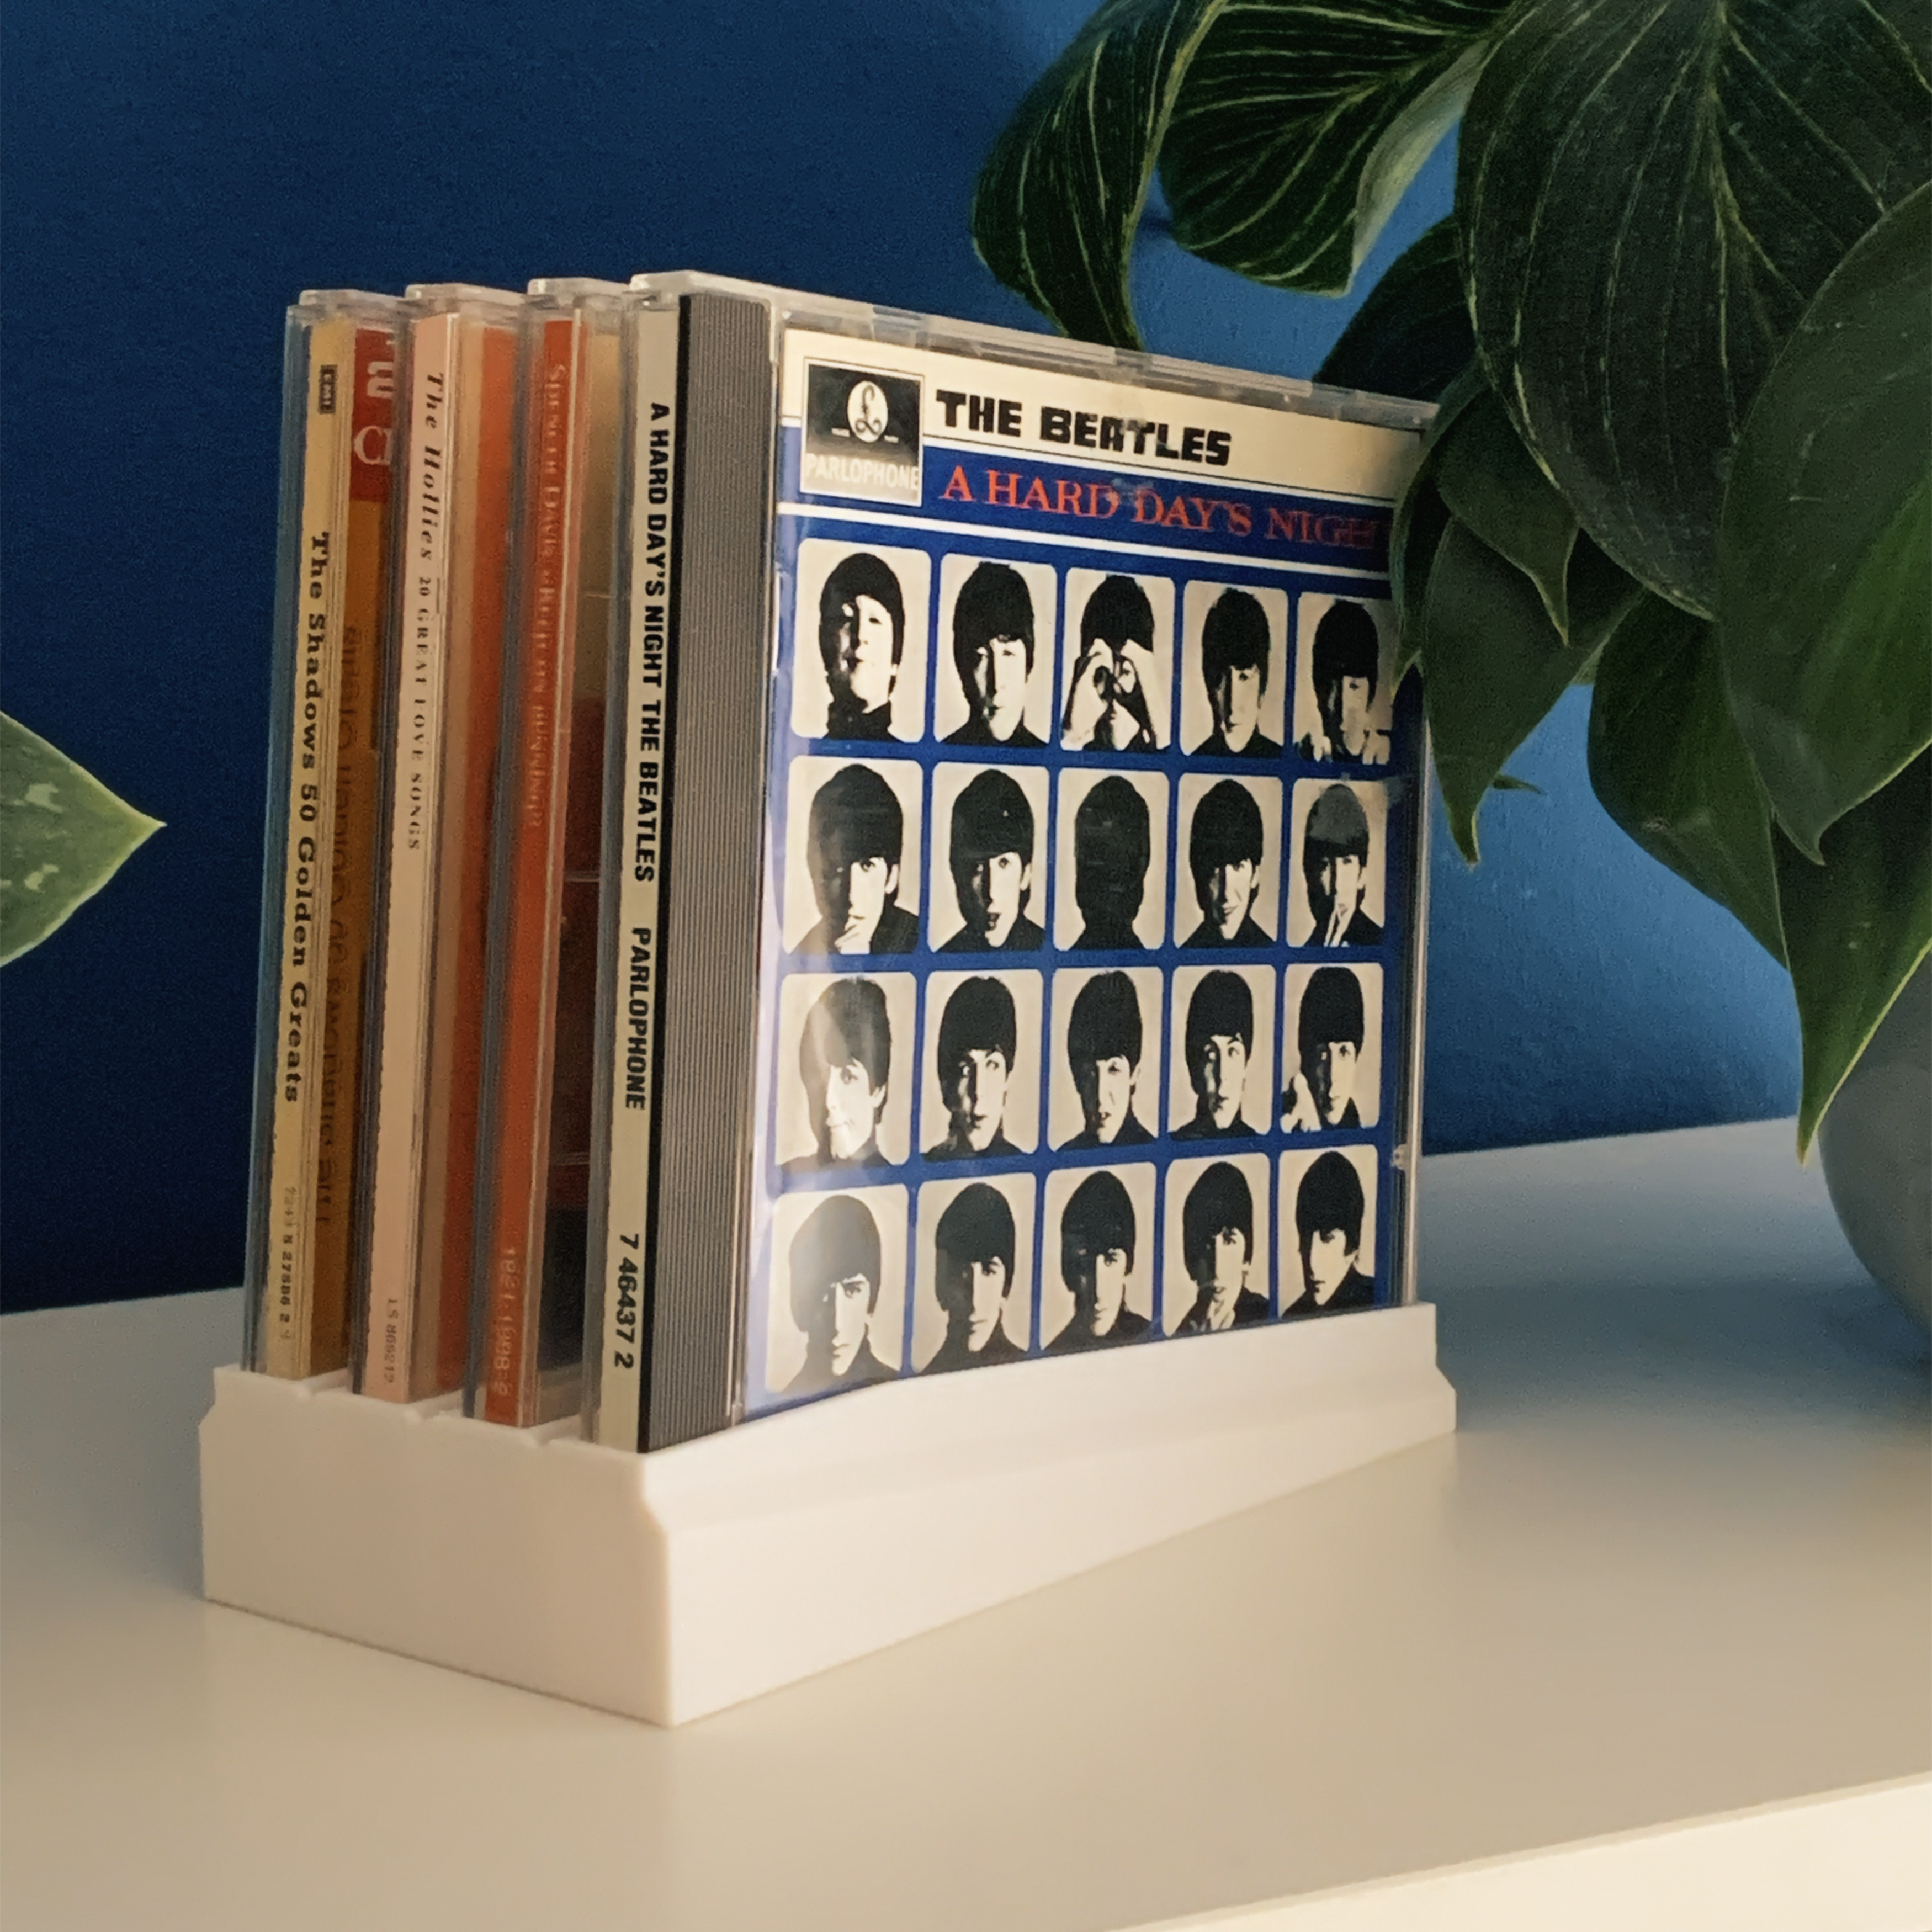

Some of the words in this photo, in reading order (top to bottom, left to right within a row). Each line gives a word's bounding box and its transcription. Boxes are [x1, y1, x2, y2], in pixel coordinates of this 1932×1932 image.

[425, 373, 444, 429] The
[651, 402, 670, 421] A
[936, 389, 1022, 437] THE
[1039, 405, 1232, 466] BEATLES
[420, 445, 442, 560] Hollies
[648, 429, 669, 505] HARD
[805, 453, 920, 490] PARLOPHONE
[939, 465, 974, 501] A
[985, 469, 1121, 519] HARD
[1130, 488, 1252, 538] DAY'S
[1265, 507, 1388, 549] NIGH
[310, 532, 330, 599] The
[418, 576, 431, 596] 20
[645, 514, 666, 597] DAY'S
[415, 608, 431, 684] GREAT
[643, 605, 665, 687] NIGHT
[302, 613, 326, 770] Shadows
[411, 699, 427, 760] LOVE
[640, 700, 661, 751] THE
[299, 784, 317, 822] 50
[408, 773, 424, 850] SONGS
[635, 762, 659, 882] BEATLES
[293, 837, 316, 967] Golden
[285, 981, 307, 1102] Greats
[625, 927, 651, 1110] PARLOPHONE
[620, 1234, 639, 1250] 7
[616, 1257, 638, 1344] 46437
[614, 1351, 634, 1369] 2
